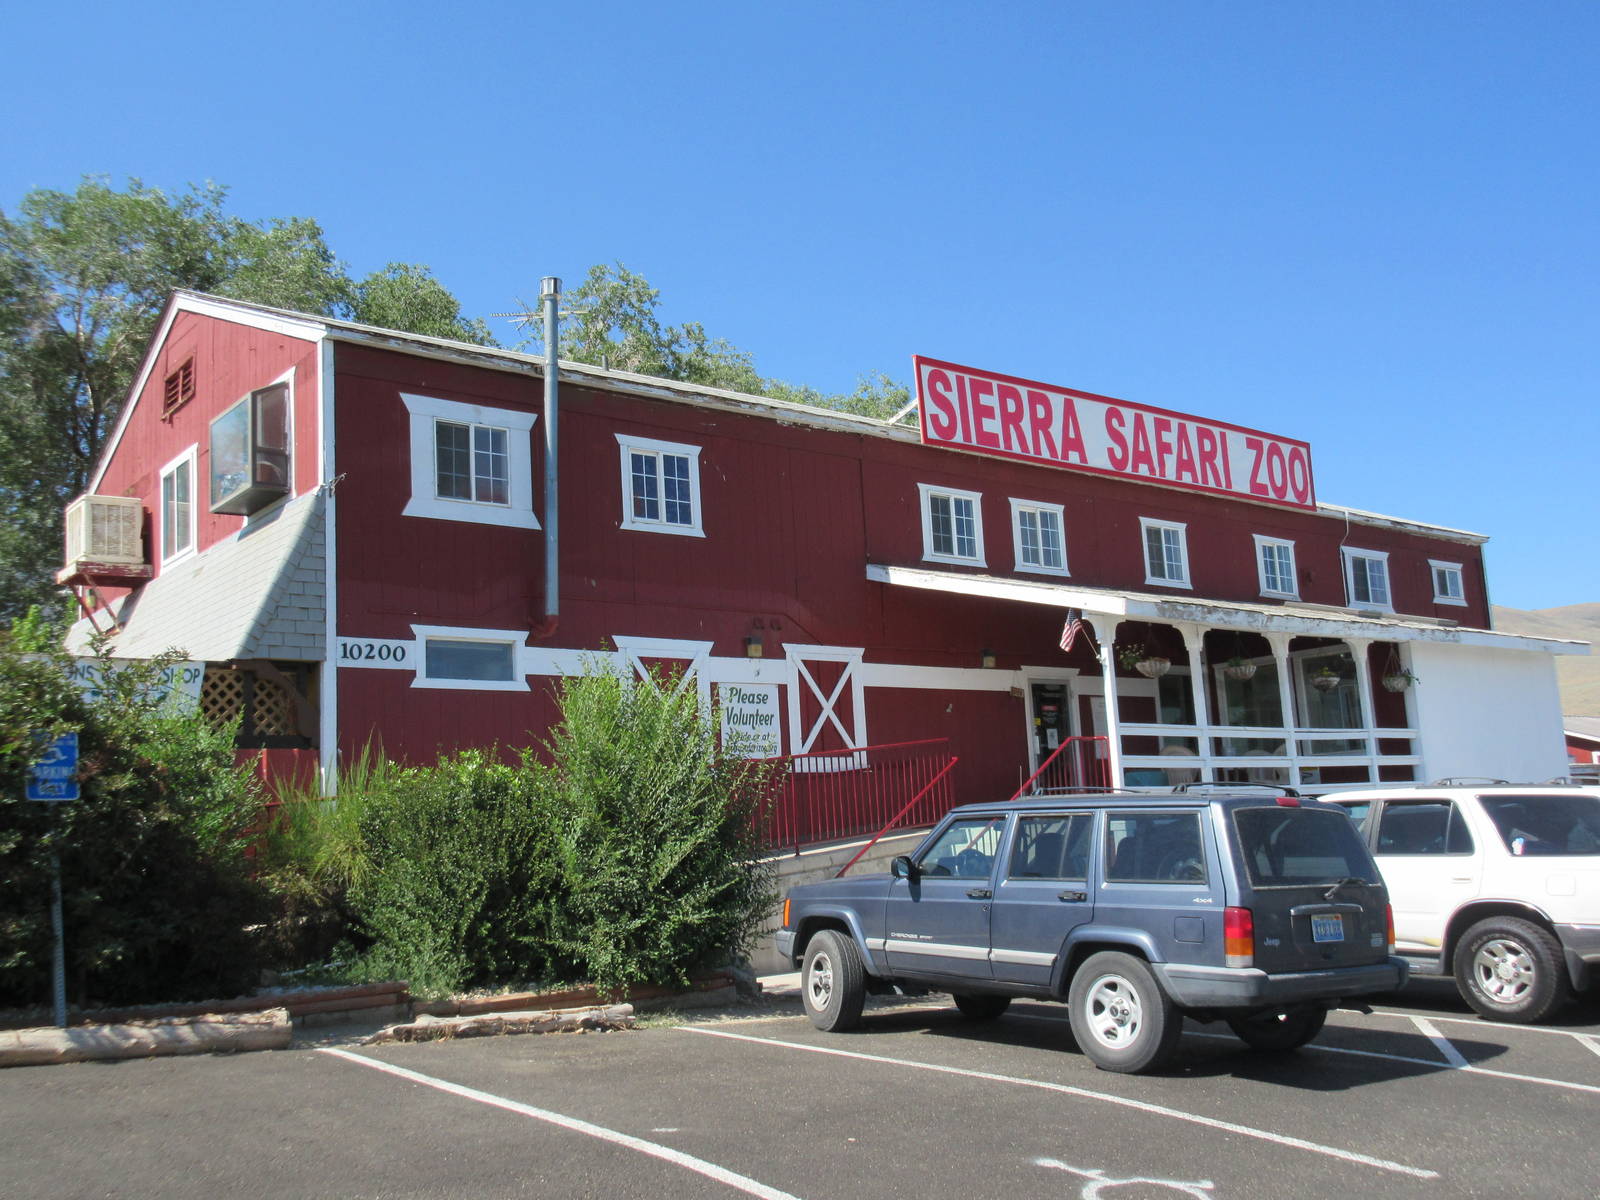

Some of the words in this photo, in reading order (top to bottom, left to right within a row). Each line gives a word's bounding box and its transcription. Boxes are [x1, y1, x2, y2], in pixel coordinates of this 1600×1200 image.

[927, 368, 1088, 465] SIERRA
[1104, 406, 1233, 490] SAFARI
[1245, 436, 1310, 504] ZOO
[341, 643, 406, 662] 10200
[728, 687, 768, 704] Please
[726, 706, 775, 730] Volunteer
